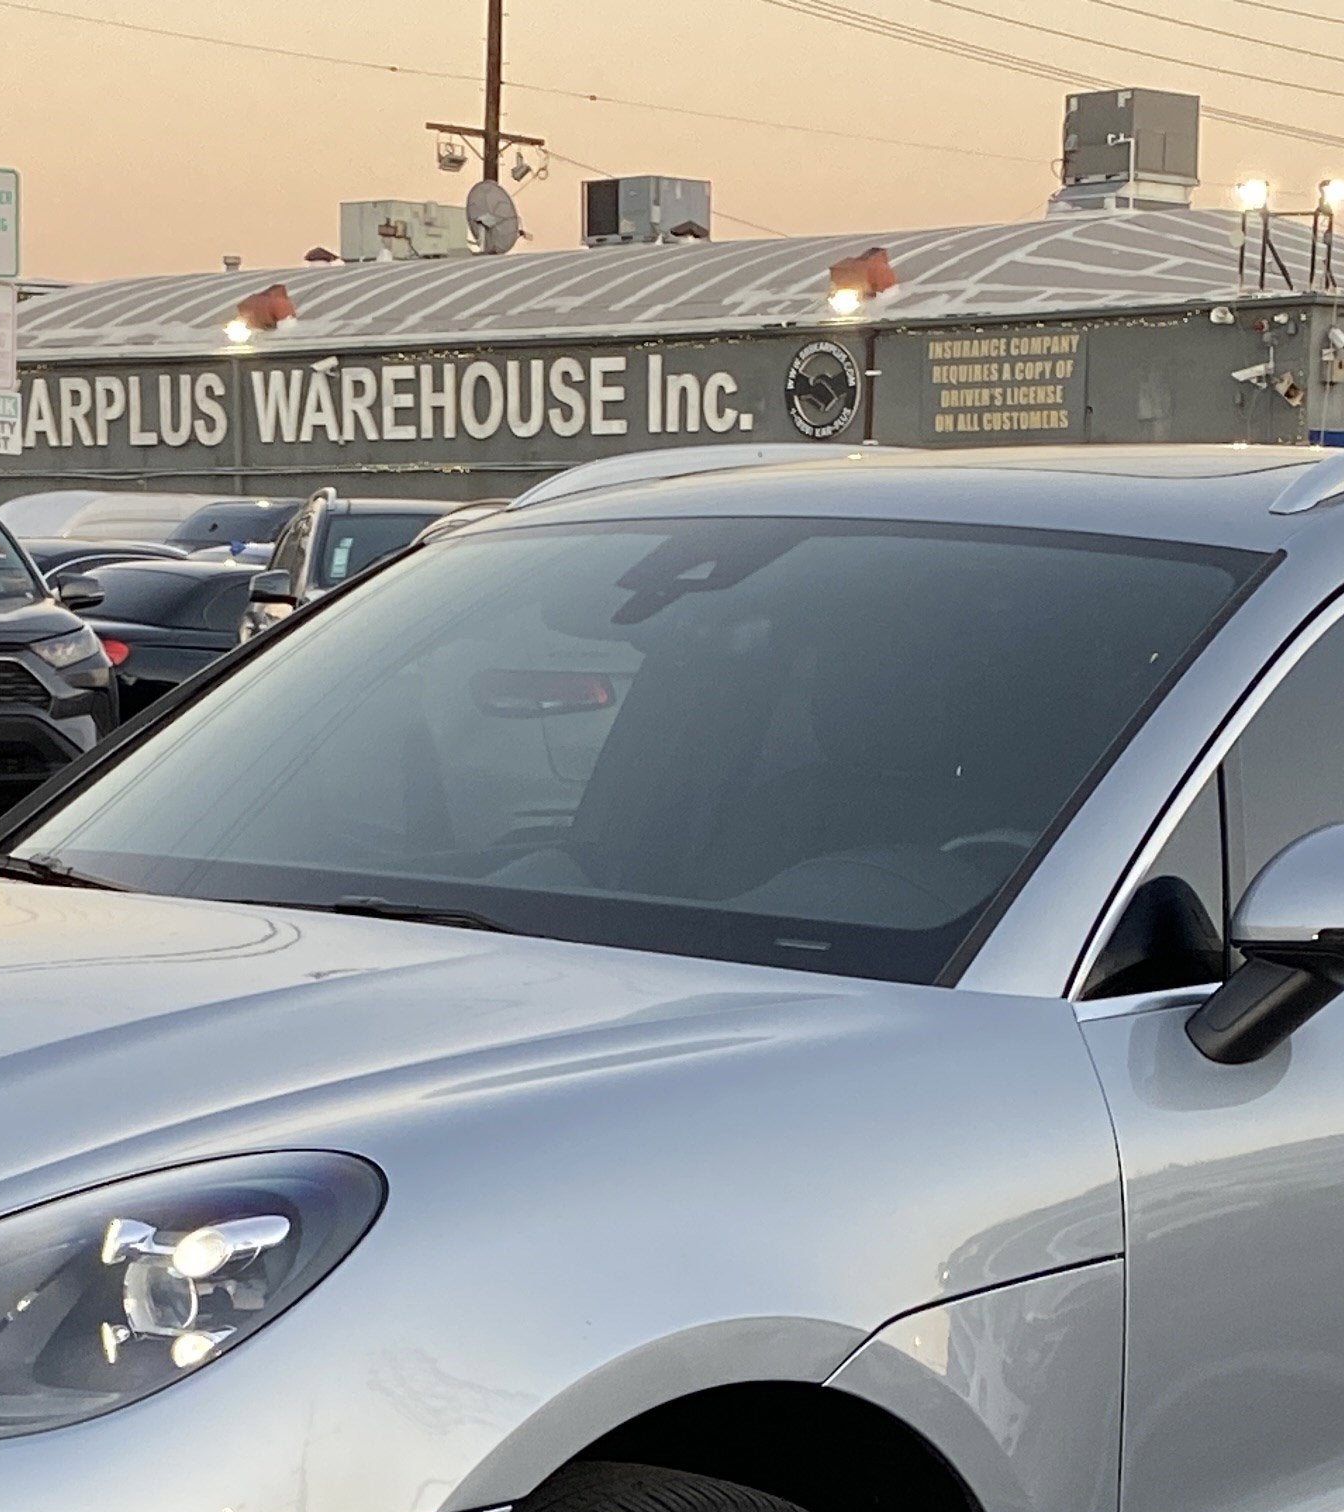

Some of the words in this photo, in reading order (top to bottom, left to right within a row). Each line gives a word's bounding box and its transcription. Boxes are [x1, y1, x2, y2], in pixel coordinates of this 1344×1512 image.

[928, 338, 1006, 359] INSURANCE
[1010, 335, 1080, 356] COMPANY
[932, 363, 998, 385] REQUIRES
[1002, 363, 1011, 381] A
[1015, 360, 1052, 380] COPY
[1055, 359, 1074, 378] OF
[22, 372, 227, 447] ARPLUS
[251, 356, 627, 443] WAREHOUSE
[648, 354, 753, 434] Inc.
[940, 388, 1003, 408] DRIVER'S
[1006, 385, 1064, 405] LICENSE
[934, 413, 954, 433] ON
[957, 413, 980, 432] ALL
[982, 410, 1069, 431] CUSTOMERS
